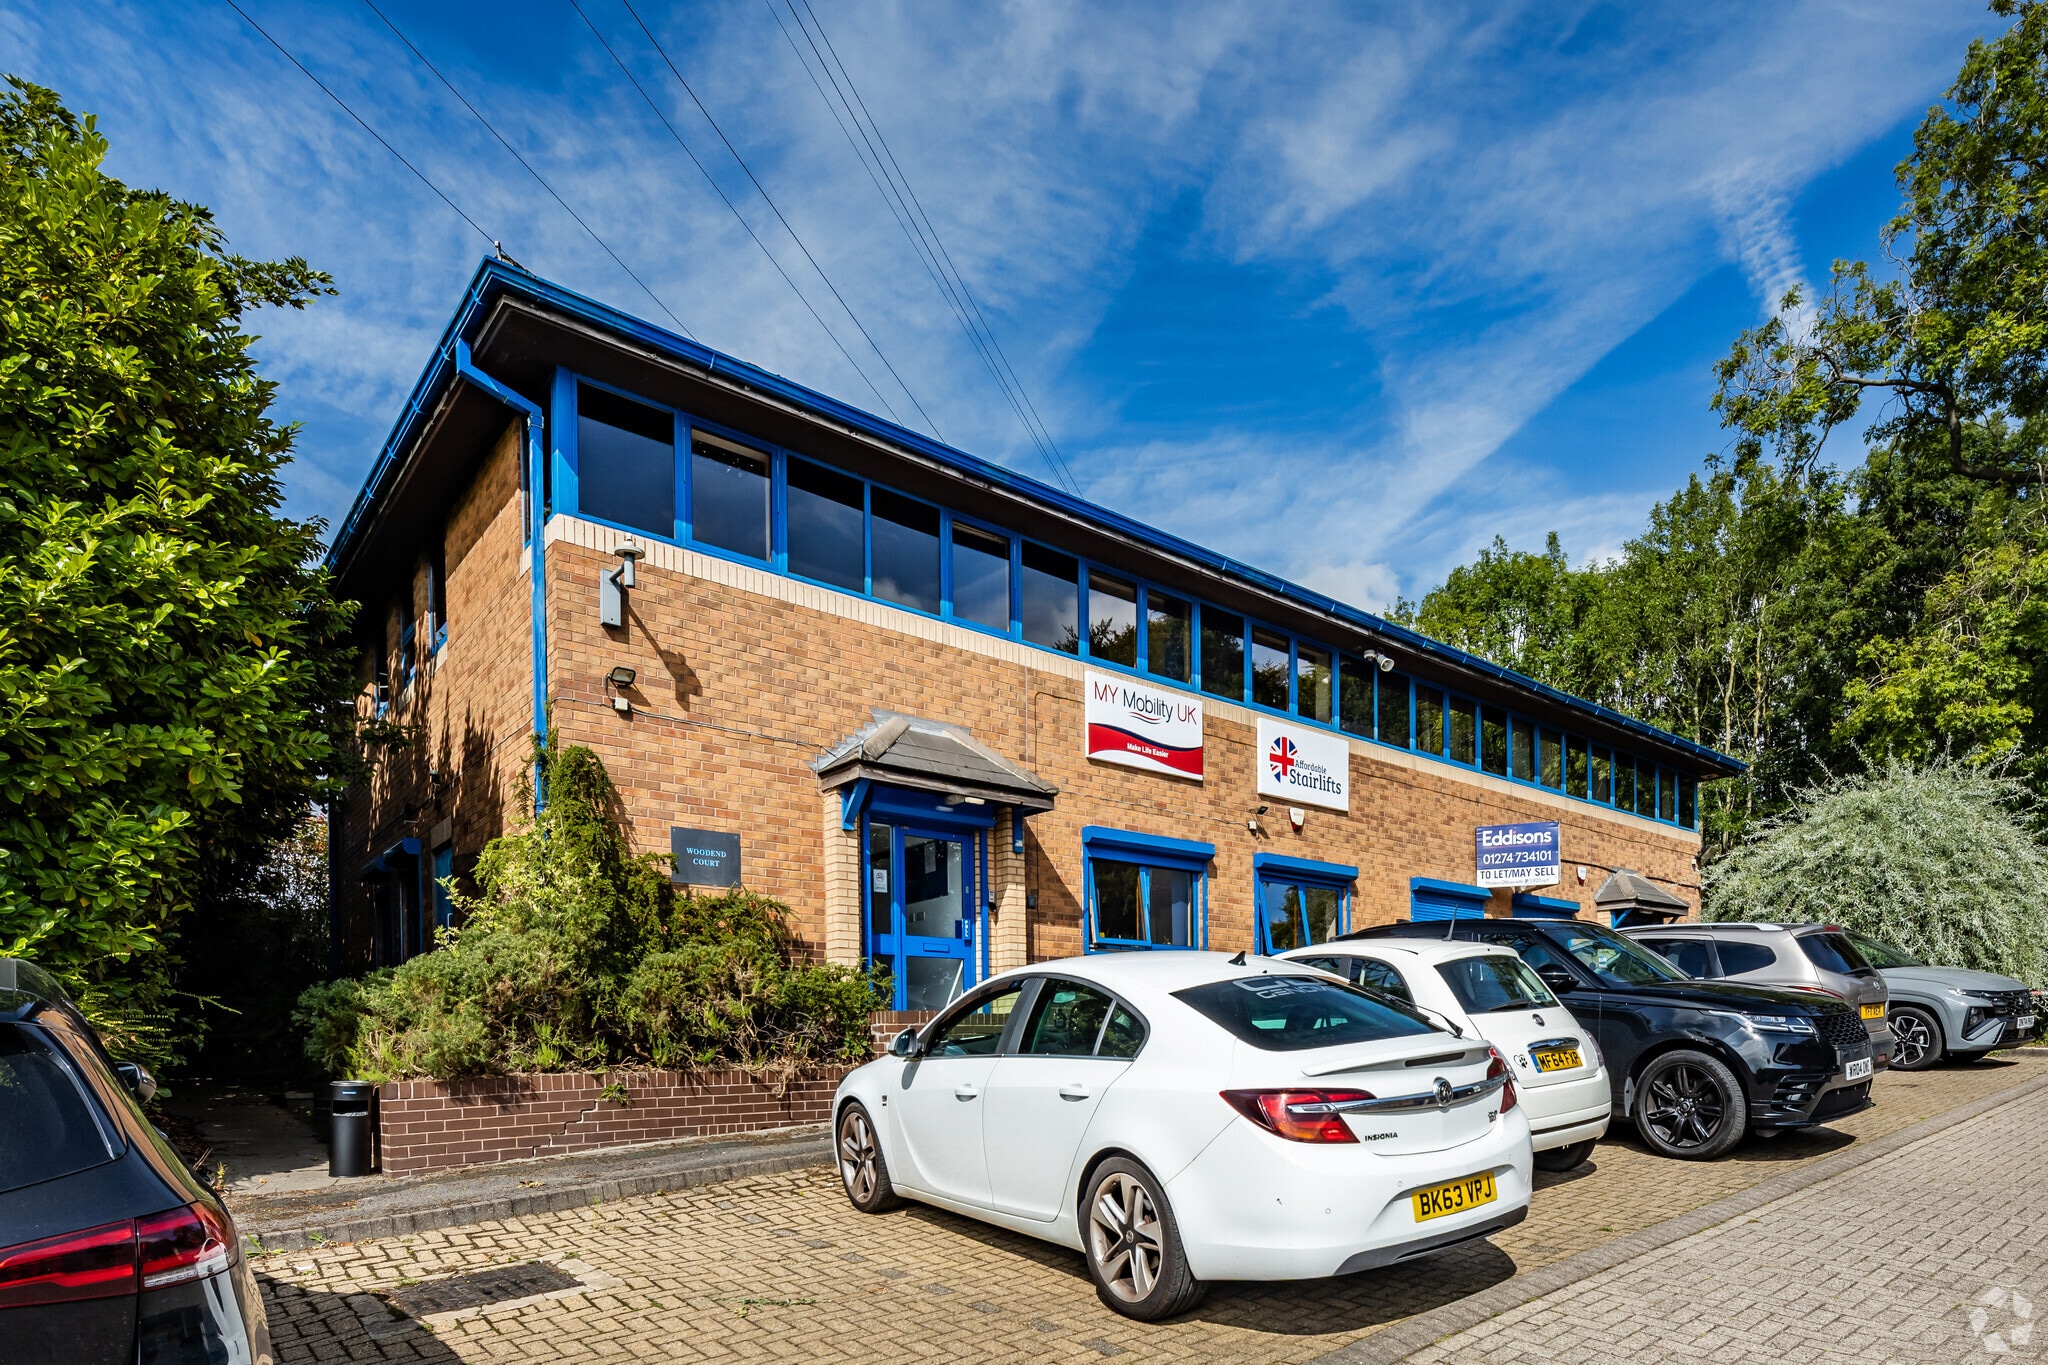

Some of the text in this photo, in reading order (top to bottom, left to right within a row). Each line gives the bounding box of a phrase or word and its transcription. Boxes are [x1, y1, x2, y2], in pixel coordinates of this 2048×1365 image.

[1094, 681, 1197, 725] MY Mobility UK
[1127, 742, 1169, 758] Make Life Easier
[1295, 759, 1327, 775] Affordable
[1289, 768, 1342, 795] Stairlifts
[1482, 829, 1552, 847] Eddisons
[686, 847, 727, 858] WOODEND
[1483, 850, 1552, 865] 01274 734101
[693, 858, 720, 867] COURT
[1480, 866, 1555, 880] TO LET/MAY SELL
[1538, 1053, 1565, 1069] MF64
[1365, 1132, 1398, 1142] INSIGNIA
[1419, 1176, 1492, 1216] BK63 VPJ
